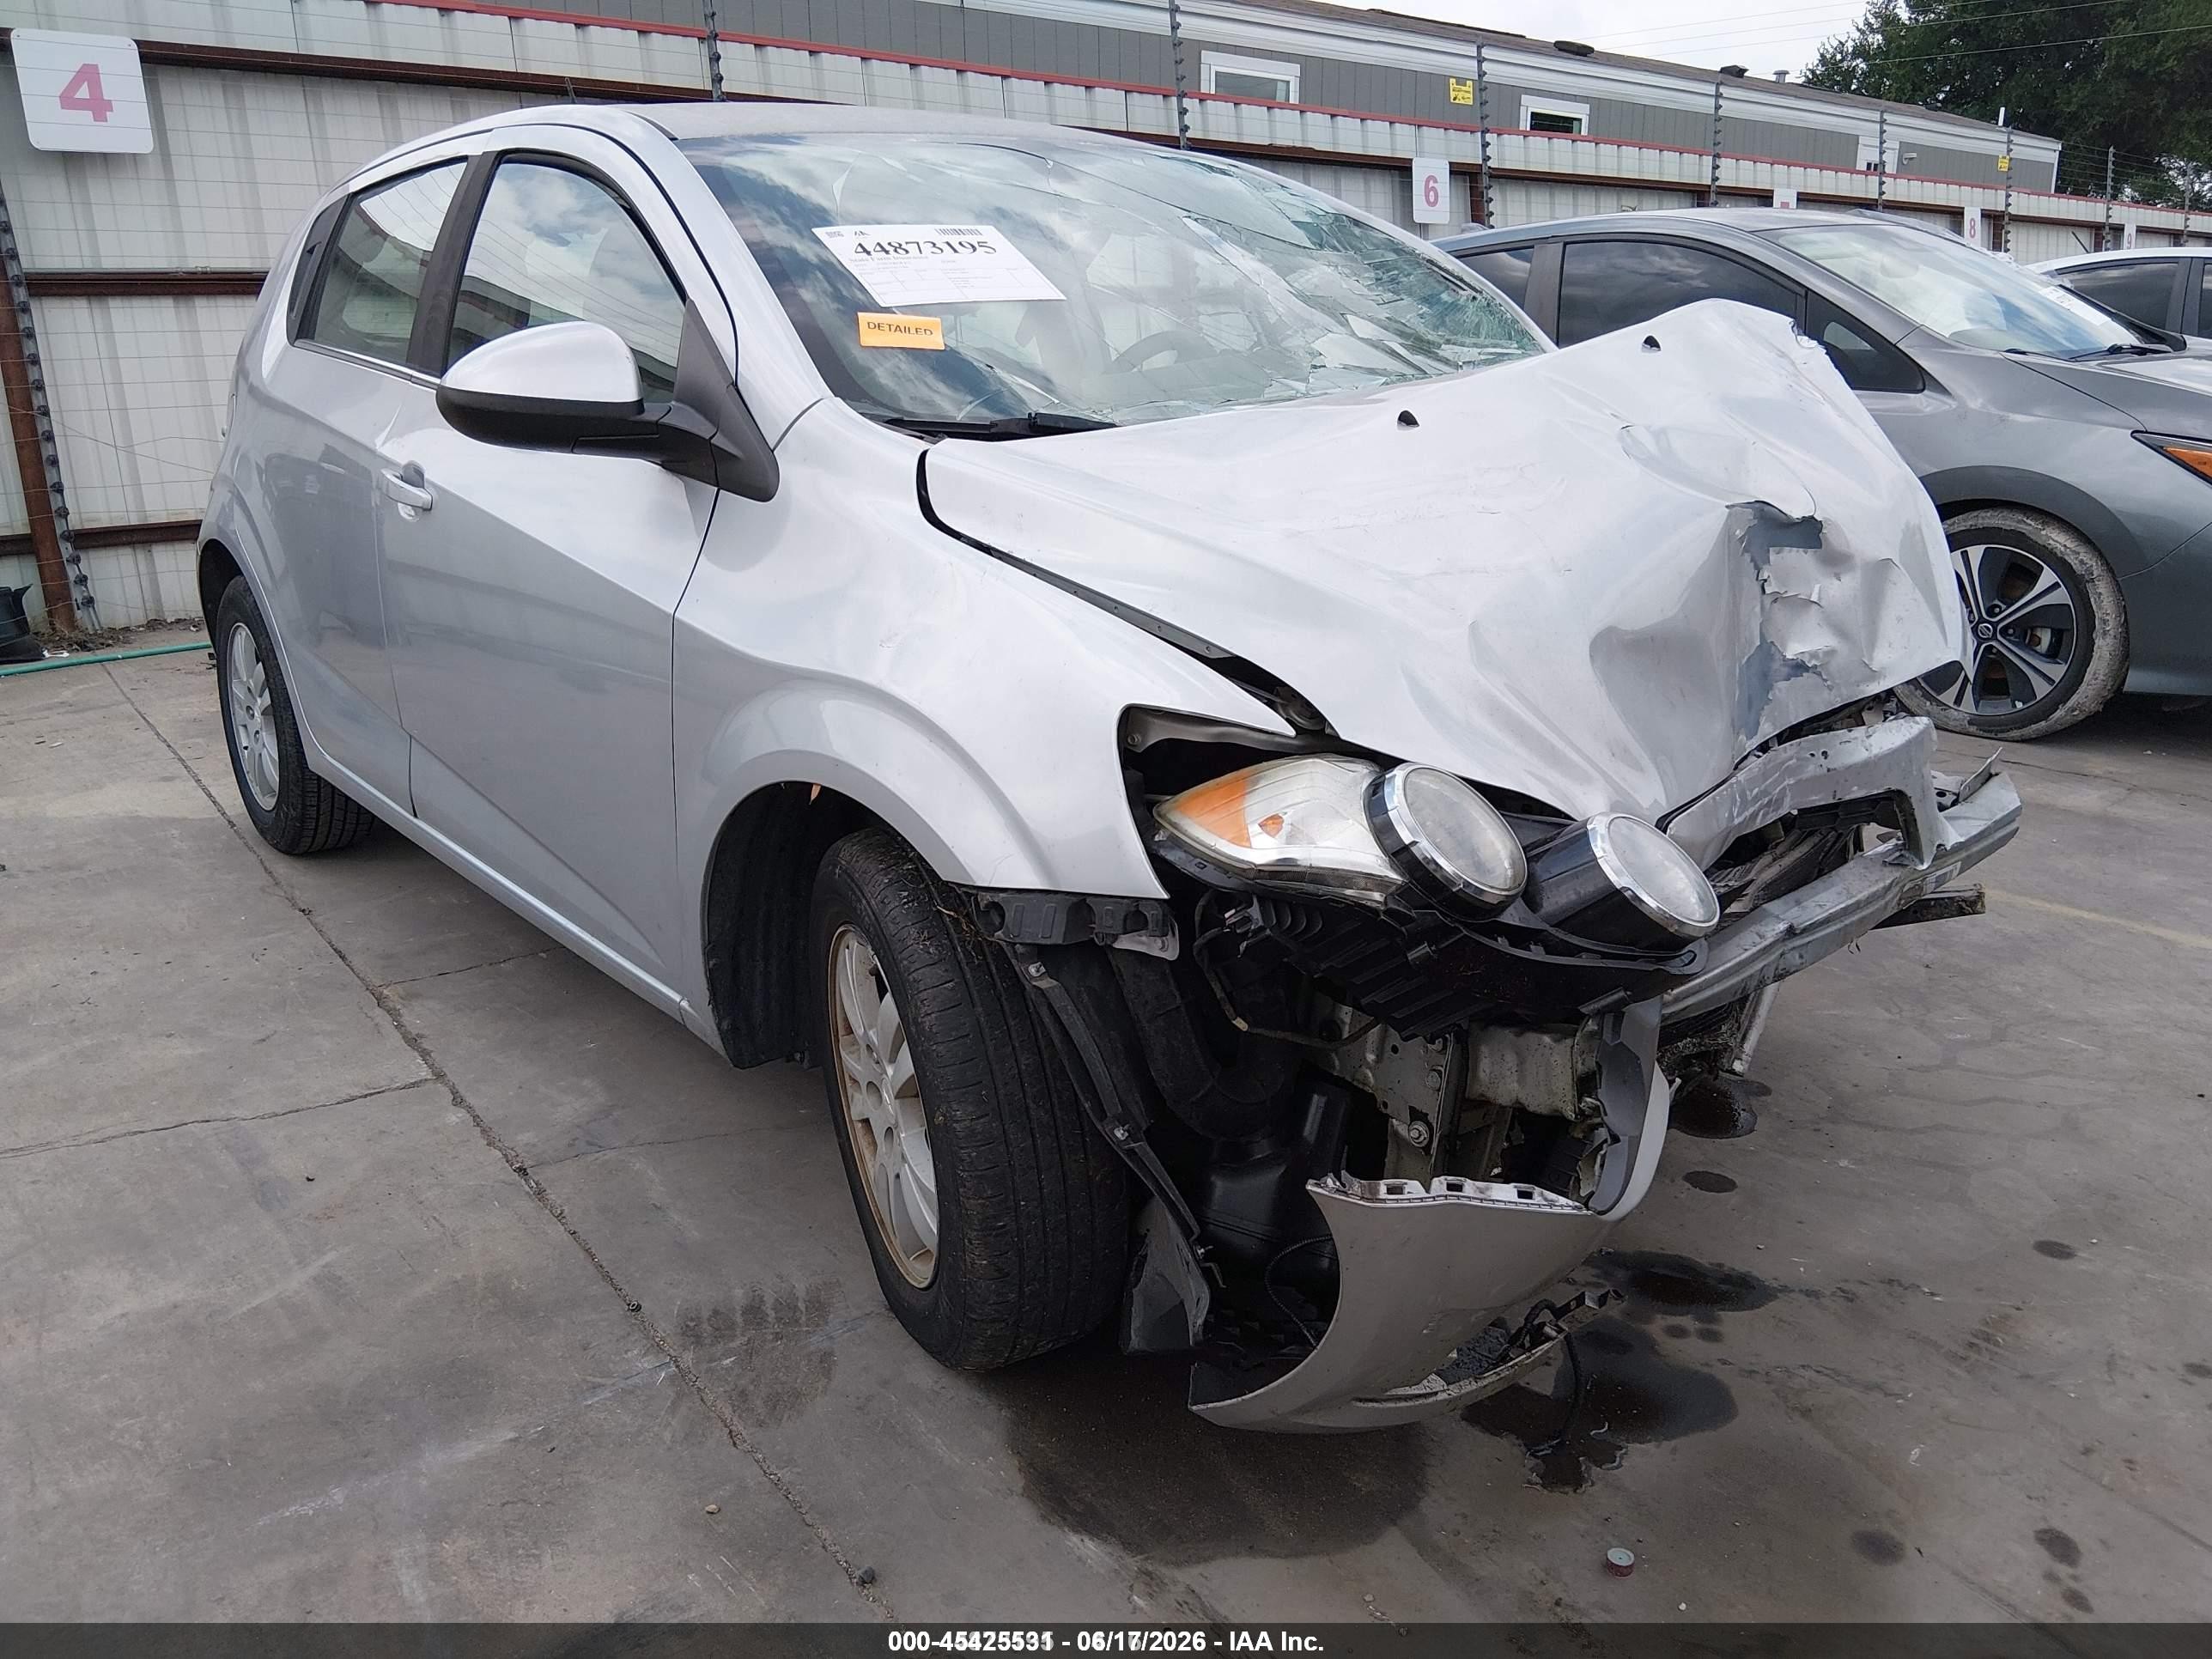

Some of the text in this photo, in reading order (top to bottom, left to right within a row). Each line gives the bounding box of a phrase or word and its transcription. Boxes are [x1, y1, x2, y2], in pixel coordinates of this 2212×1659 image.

[59, 63, 113, 123] 4
[1425, 174, 1439, 208] 6
[1969, 217, 1976, 239] 8
[854, 240, 997, 256] 44873195
[867, 321, 933, 336] DETAILED
